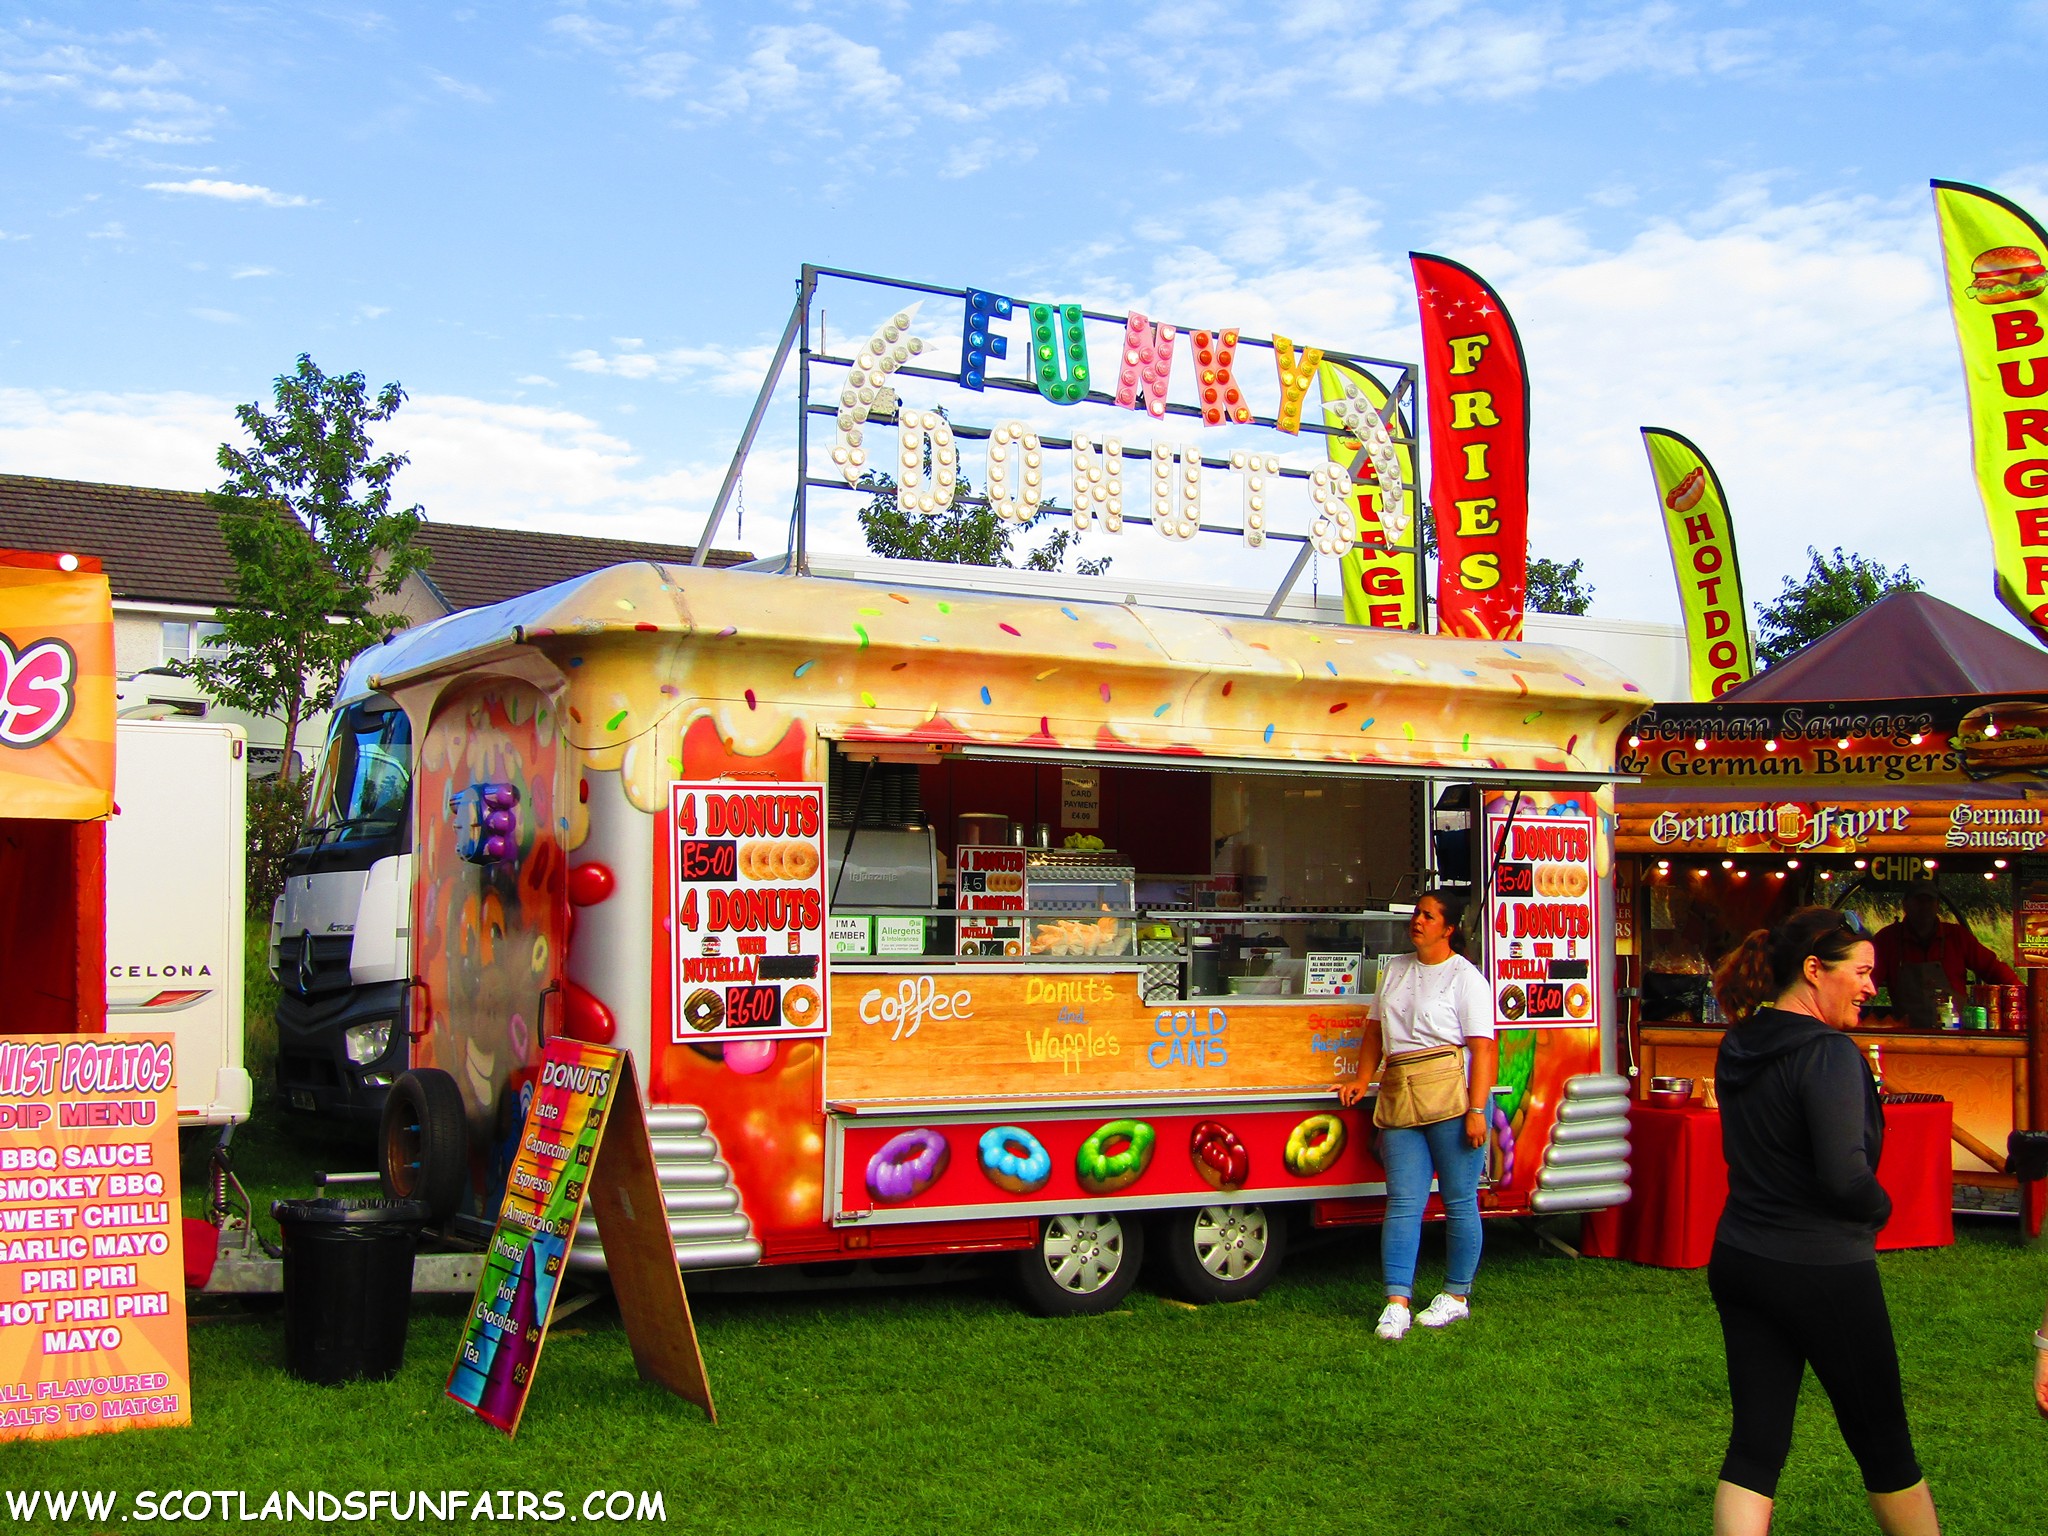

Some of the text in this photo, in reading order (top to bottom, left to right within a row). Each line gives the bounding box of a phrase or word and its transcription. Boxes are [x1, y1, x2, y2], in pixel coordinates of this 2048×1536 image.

[960, 287, 1324, 435] FUNKY
[1449, 333, 1500, 592] FRIES
[897, 410, 1355, 558] DONUTS
[1637, 708, 1932, 747] German Sausage
[1620, 749, 1957, 780] & German Burgers
[1064, 800, 1098, 809] PAYMENT
[1071, 790, 1092, 798] CARD
[678, 793, 820, 838] 4 DONUTS
[1650, 808, 1776, 845] German
[1798, 805, 1911, 850] Fayre
[1950, 803, 2041, 825] German
[1511, 826, 1588, 862] DONUTS
[1945, 825, 2047, 851] Sausage
[960, 850, 1023, 872] 4 DONUTS
[681, 888, 821, 933] 4 DONUTS
[836, 920, 856, 928] I'M A
[1495, 903, 1590, 940] 4 DONUTS
[881, 927, 921, 936] Allergens
[110, 965, 211, 977] CELONA
[1026, 977, 1114, 1005] Donut's
[1154, 1007, 1228, 1038] COLD
[1026, 1027, 1120, 1075] Waffle's
[1147, 1037, 1228, 1069] CANS
[62, 1041, 171, 1092] POTATOS
[541, 1061, 610, 1097] DONUTS
[0, 1100, 157, 1130] DIP MENU
[535, 1098, 558, 1120] Latte
[1, 1143, 152, 1171] BBQ SAUCE
[525, 1133, 571, 1161] Capuccino
[108, 1172, 165, 1197] BBQ
[513, 1167, 553, 1195] Espresso
[82, 1202, 169, 1229] CHILLI
[504, 1201, 554, 1234] Americano
[93, 1231, 169, 1257] MAYO
[494, 1235, 523, 1263] Mocha
[22, 1264, 137, 1293] PIRI PIRI
[496, 1279, 516, 1303] Hot
[55, 1296, 110, 1321] PIRI
[115, 1292, 169, 1318] PIRI
[476, 1301, 519, 1336] Chocolate
[43, 1325, 122, 1354] MAYO
[463, 1341, 480, 1364] Tea
[37, 1372, 168, 1400] FLAVOURED
[65, 1403, 97, 1421] TO
[102, 1394, 179, 1418] MATCH
